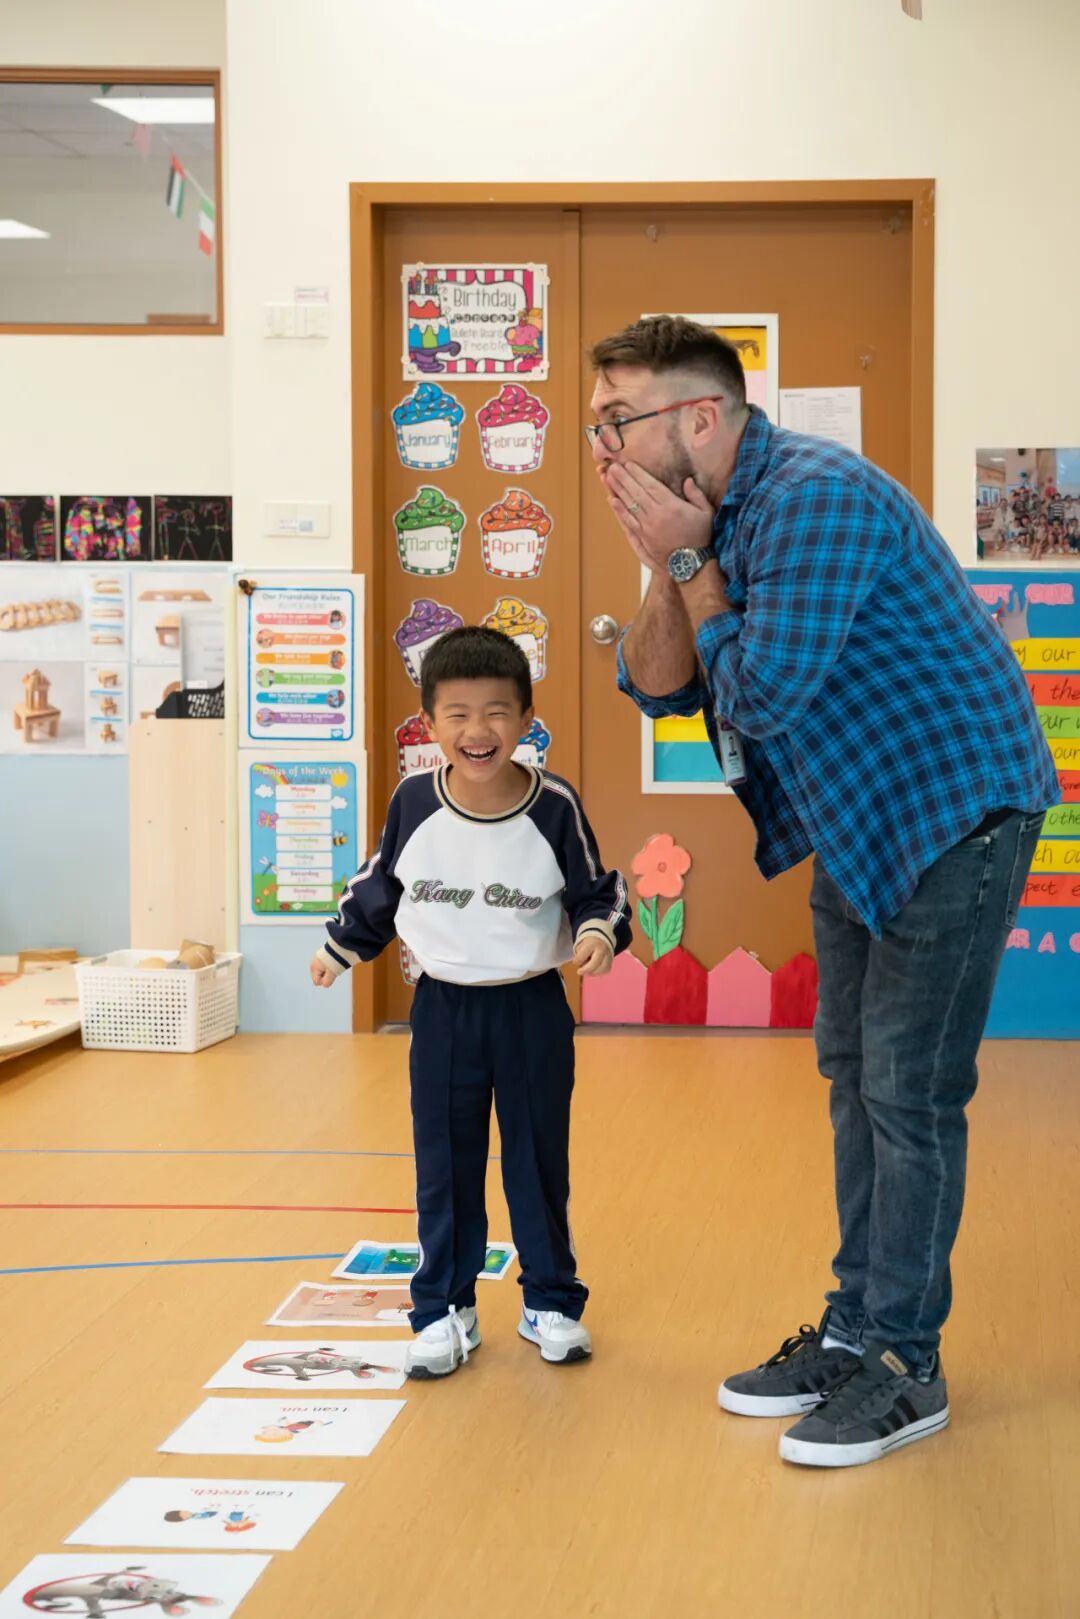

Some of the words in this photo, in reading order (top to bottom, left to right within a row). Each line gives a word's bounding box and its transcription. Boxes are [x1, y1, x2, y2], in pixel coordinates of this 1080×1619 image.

[453, 287, 517, 311] Birthday
[405, 433, 450, 448] January
[488, 434, 535, 449] February
[405, 537, 452, 552] March
[491, 539, 535, 555] April
[1042, 648, 1077, 662] our
[289, 766, 298, 776] of
[300, 767, 317, 775] the
[410, 879, 475, 909] Kang
[484, 882, 543, 910] Chiao
[191, 1488, 251, 1498] stretch.
